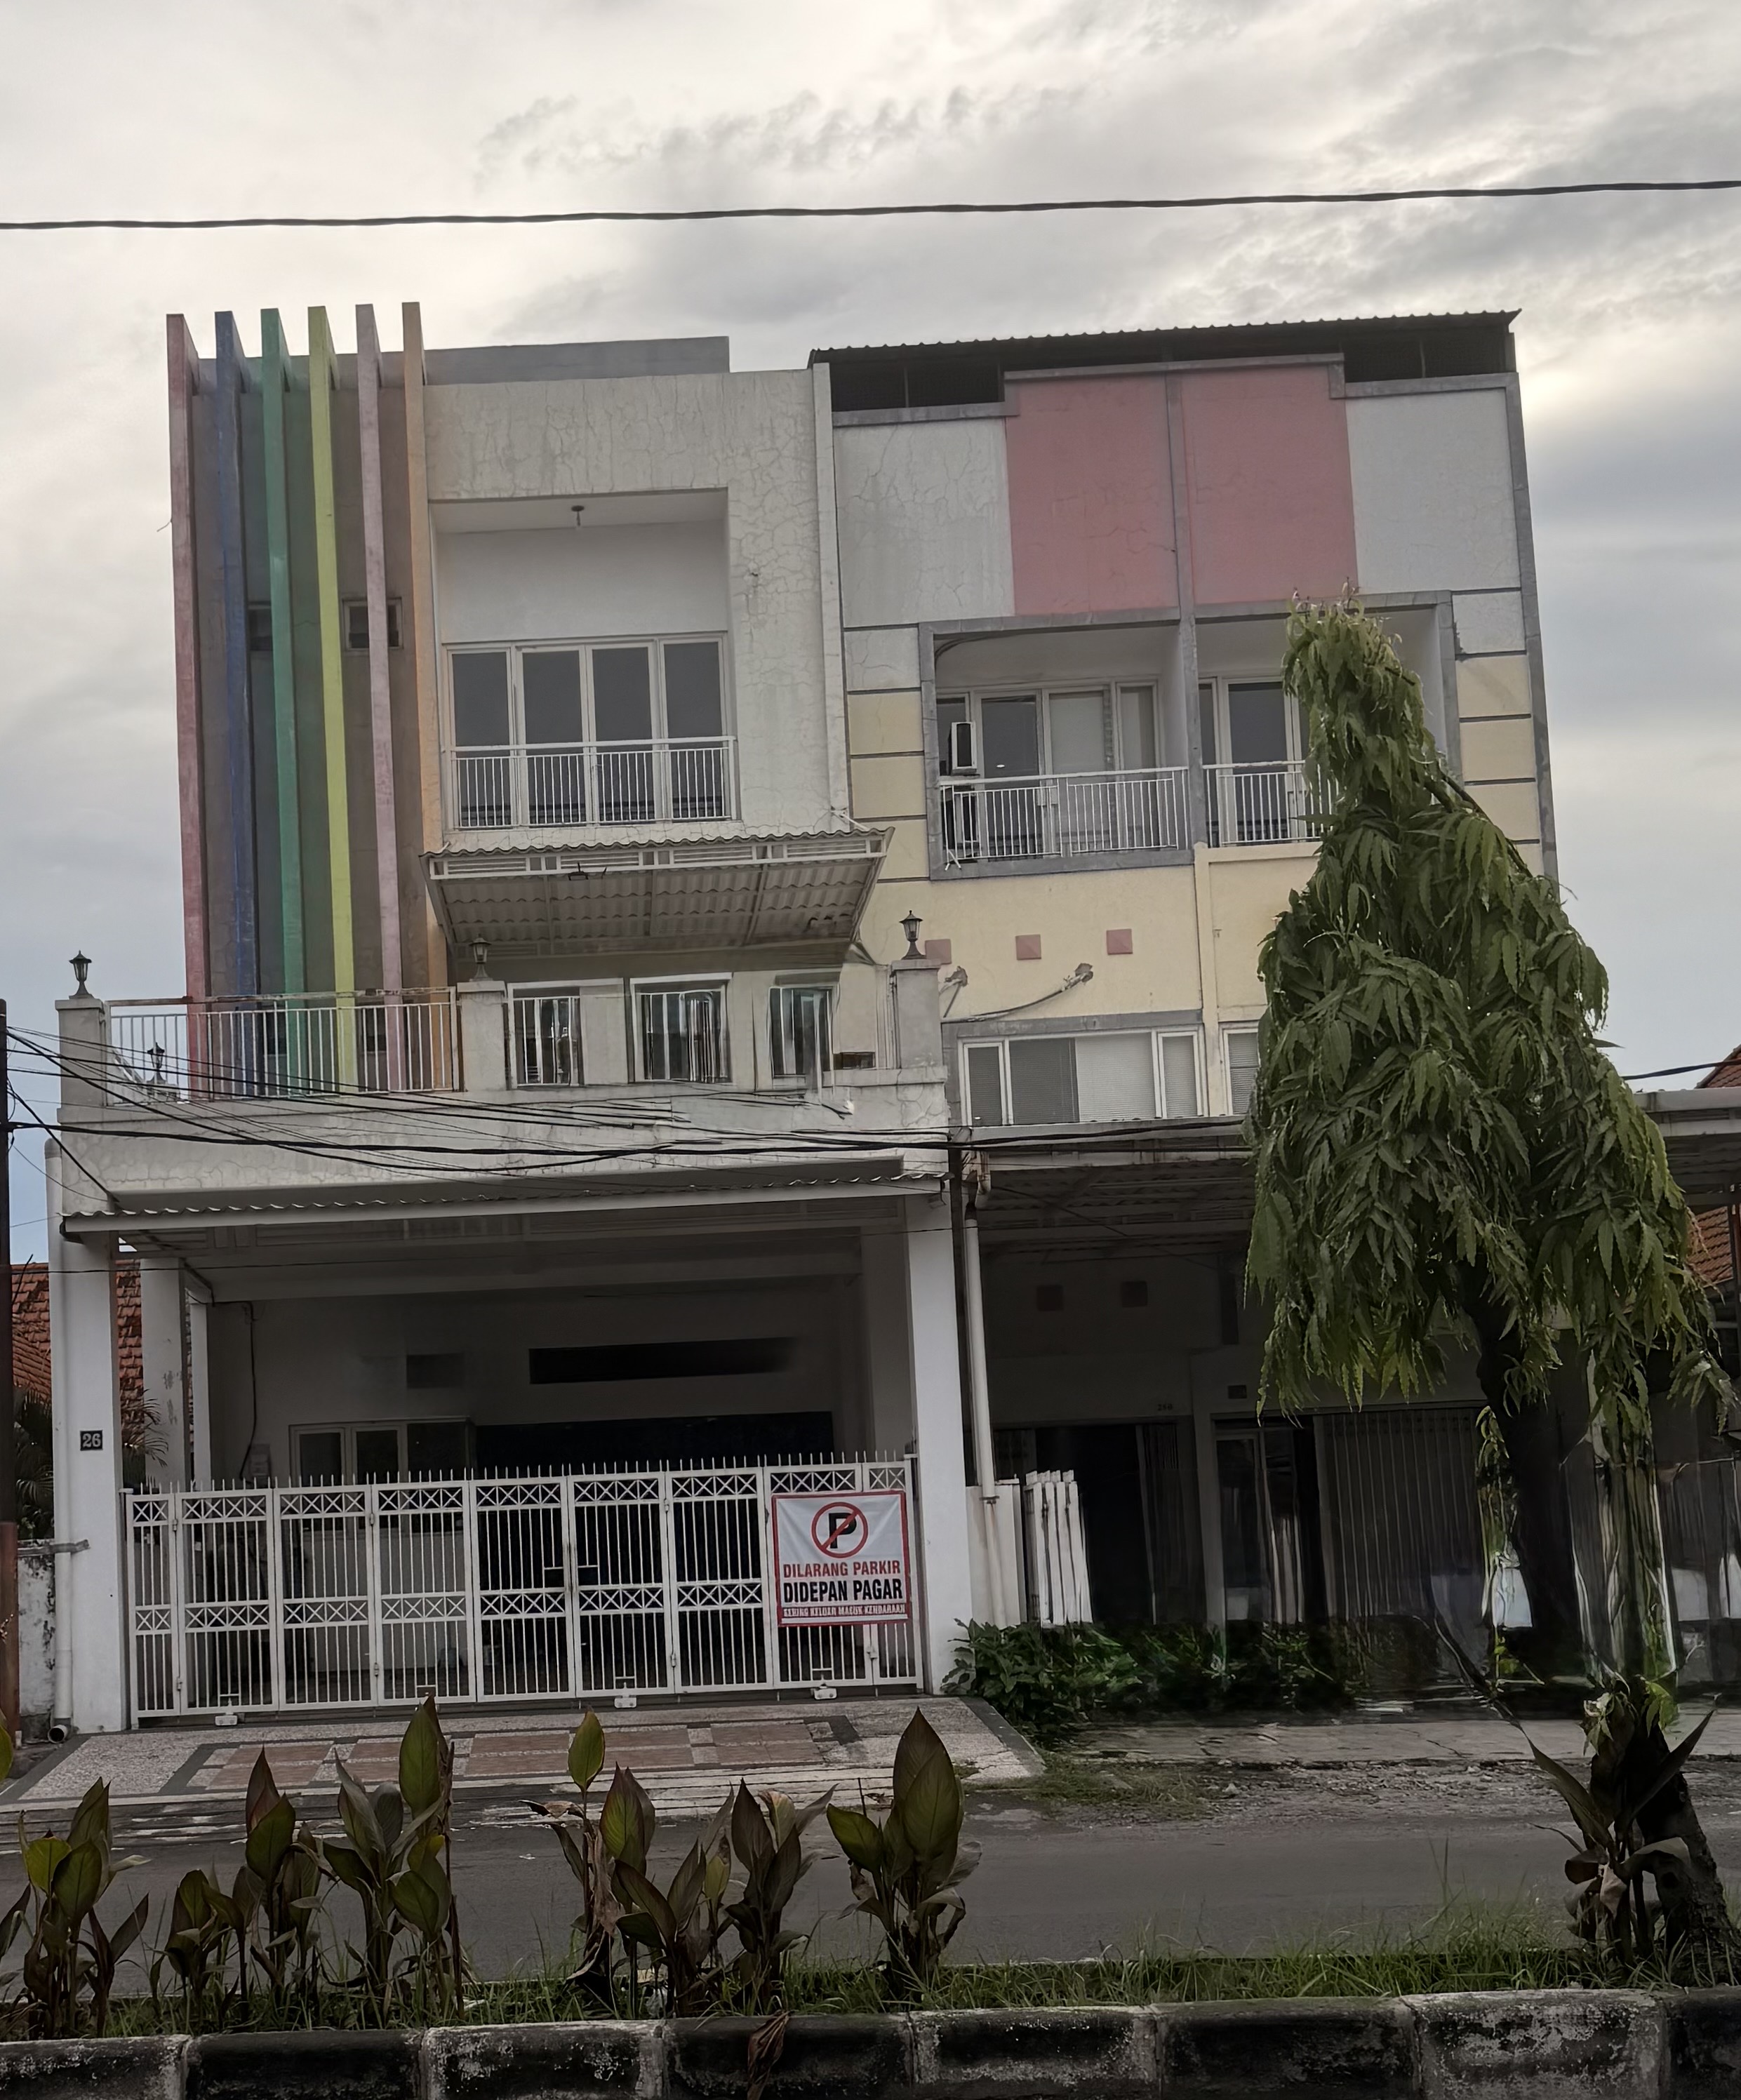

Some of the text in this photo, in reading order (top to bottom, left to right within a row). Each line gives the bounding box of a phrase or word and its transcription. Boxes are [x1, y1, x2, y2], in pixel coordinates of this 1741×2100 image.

[82, 1433, 101, 1447] 26
[828, 1512, 857, 1549] P
[783, 1560, 901, 1578] DILARANG PARKIR
[783, 1578, 903, 1603] DIDEPAN PAGAR
[838, 1605, 864, 1616] MASUK
[864, 1603, 906, 1614] KENDARAAN
